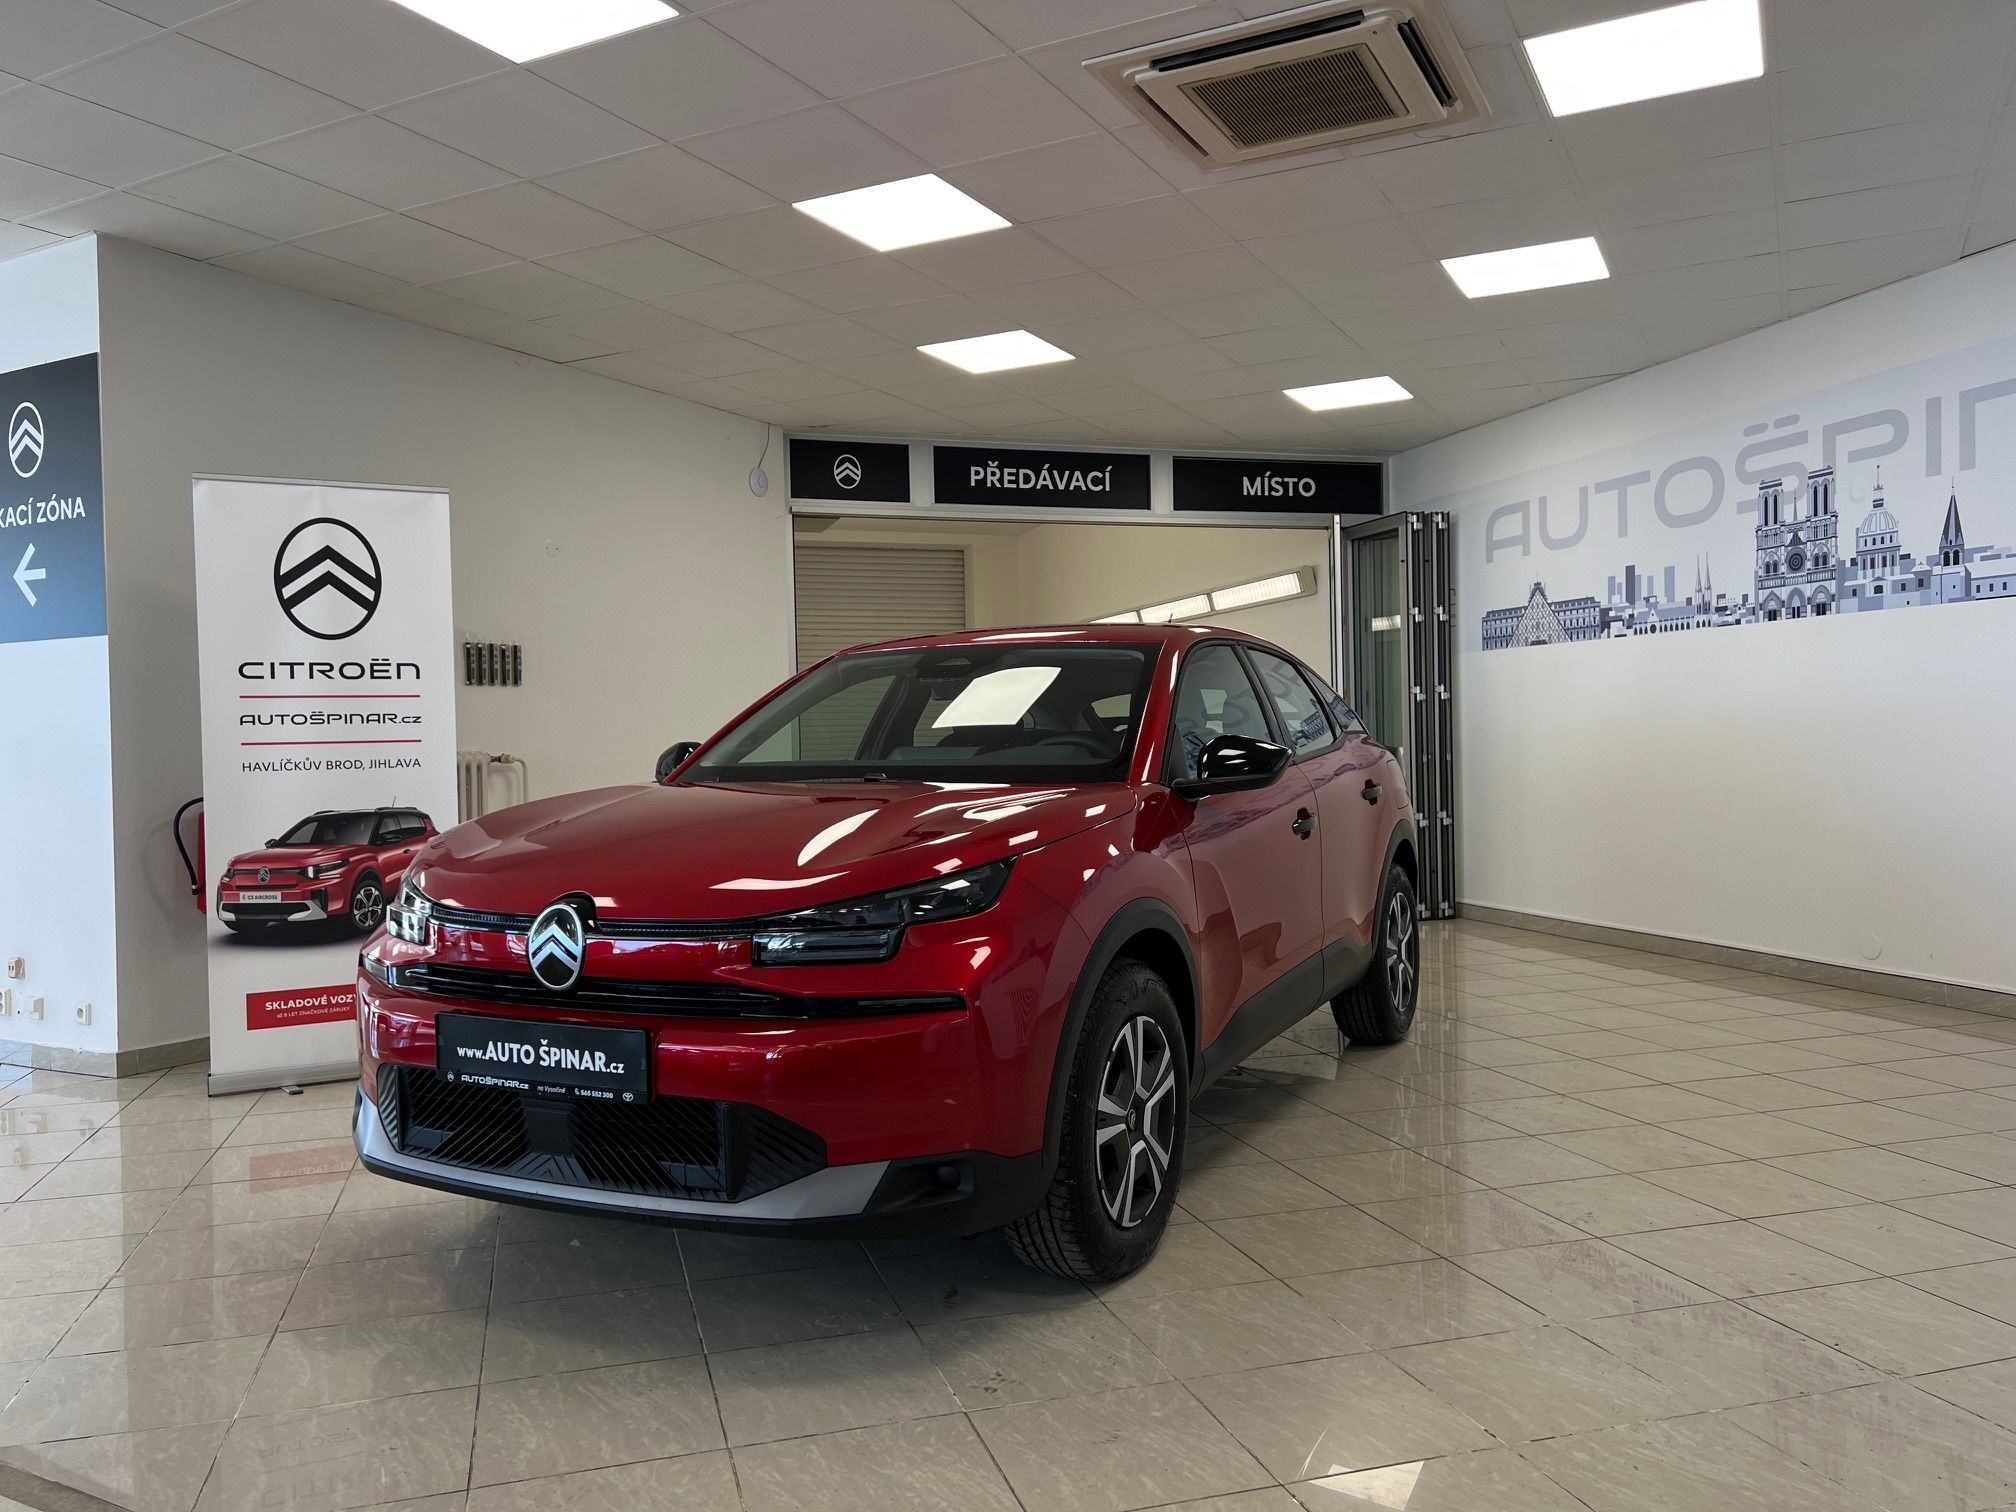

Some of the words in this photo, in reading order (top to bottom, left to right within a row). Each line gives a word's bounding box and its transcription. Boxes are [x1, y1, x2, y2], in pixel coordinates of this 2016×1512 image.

[969, 461, 1113, 492] PŘEDÁVACÍ
[1242, 471, 1317, 498] MÍSTO
[36, 493, 86, 524] ZÓNA
[238, 658, 421, 680] CITROËN
[242, 757, 322, 773] HAVLÍČKŮV
[326, 760, 365, 771] BROD,
[368, 758, 422, 770] JIHLAVA
[265, 995, 328, 1010] SKLADOVÉ
[330, 994, 356, 1004] VOZ
